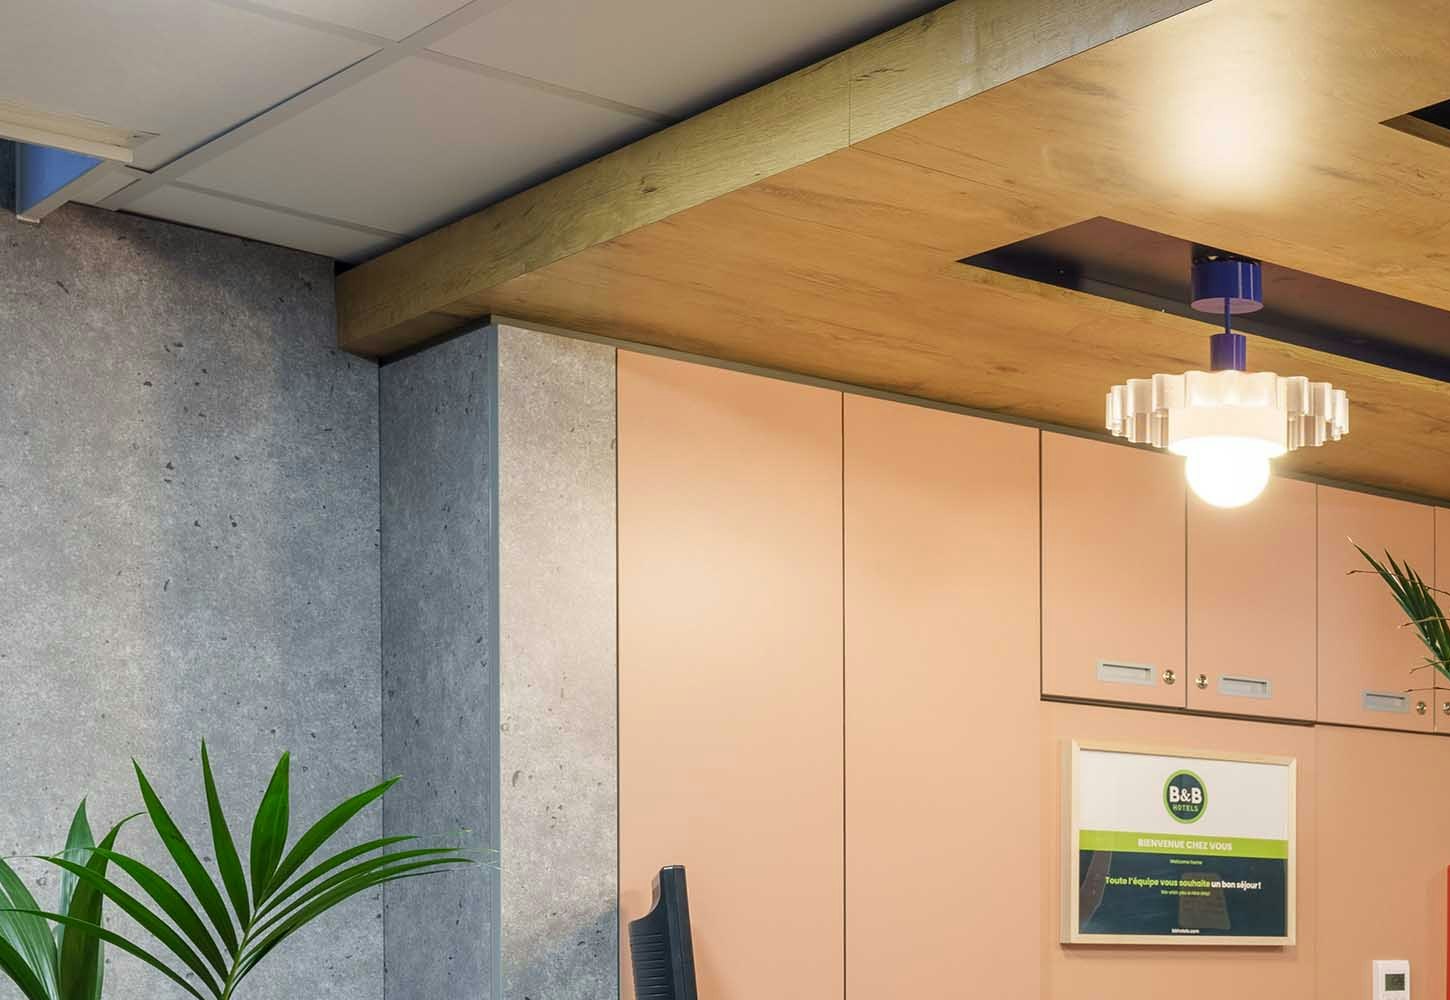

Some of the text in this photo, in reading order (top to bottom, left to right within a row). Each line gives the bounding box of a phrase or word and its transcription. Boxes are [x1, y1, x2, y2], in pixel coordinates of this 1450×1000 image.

[1169, 786, 1202, 804] B&B
[1172, 804, 1199, 812] HOTELS
[1137, 838, 1232, 851] BIENVENUE CHEZ VOUS
[1105, 877, 1127, 885] Toute
[1128, 877, 1159, 888] l'équipe
